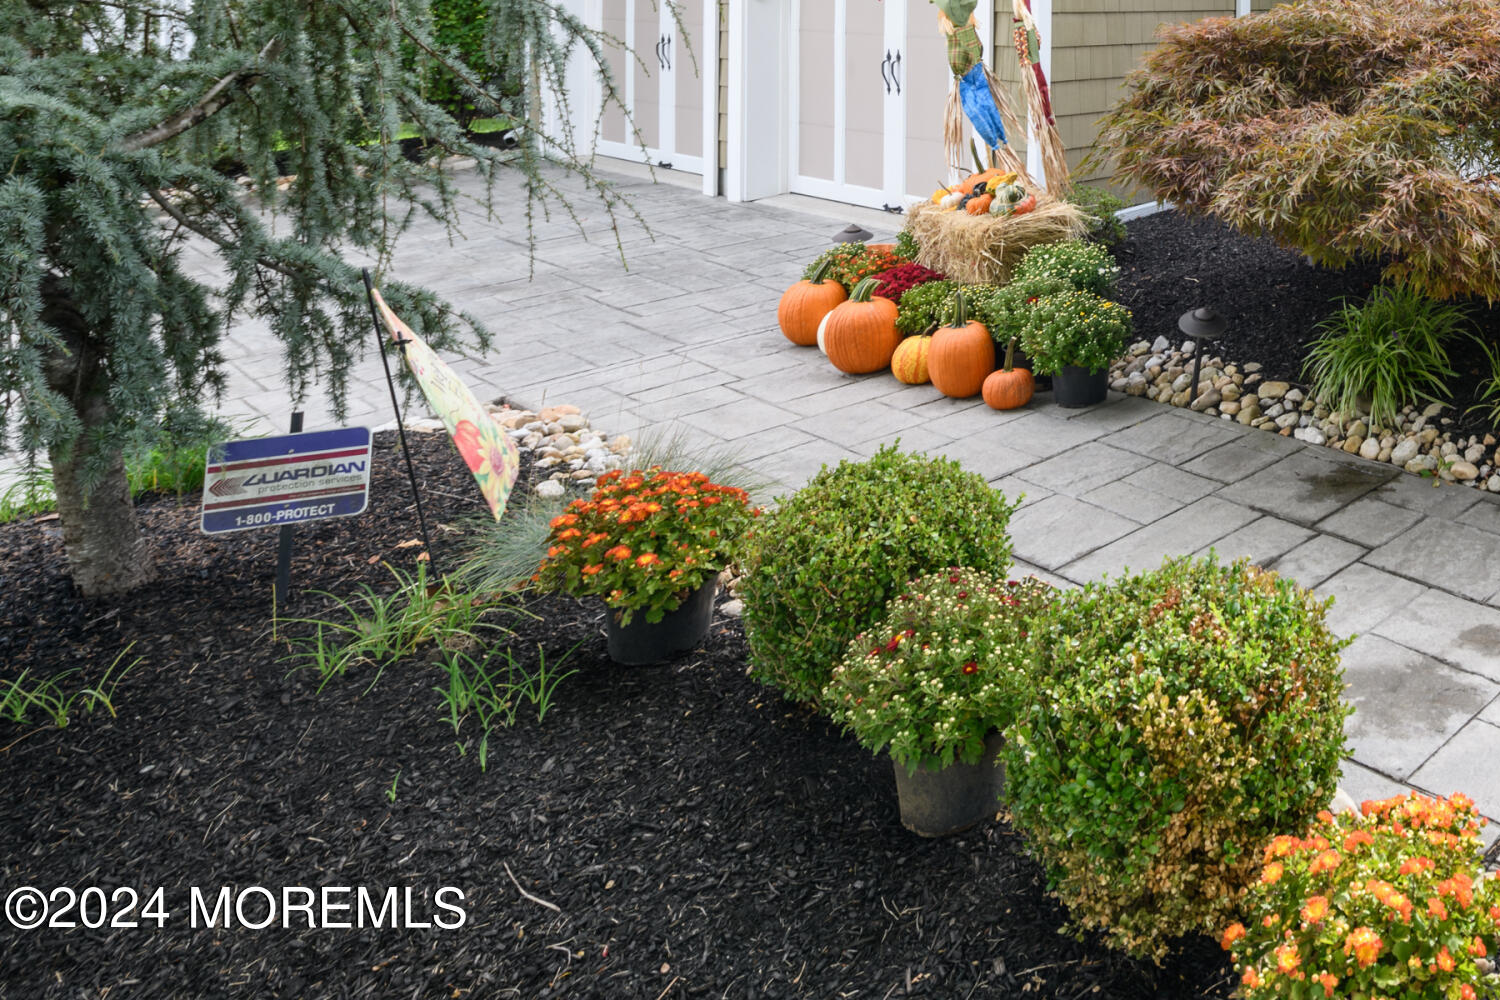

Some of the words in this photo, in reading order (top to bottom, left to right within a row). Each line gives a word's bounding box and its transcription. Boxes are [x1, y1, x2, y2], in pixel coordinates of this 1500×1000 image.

[242, 460, 366, 487] GUARDIAN
[258, 479, 315, 495] protection
[318, 474, 362, 487] services
[236, 503, 336, 527] 1-800-PROTECT
